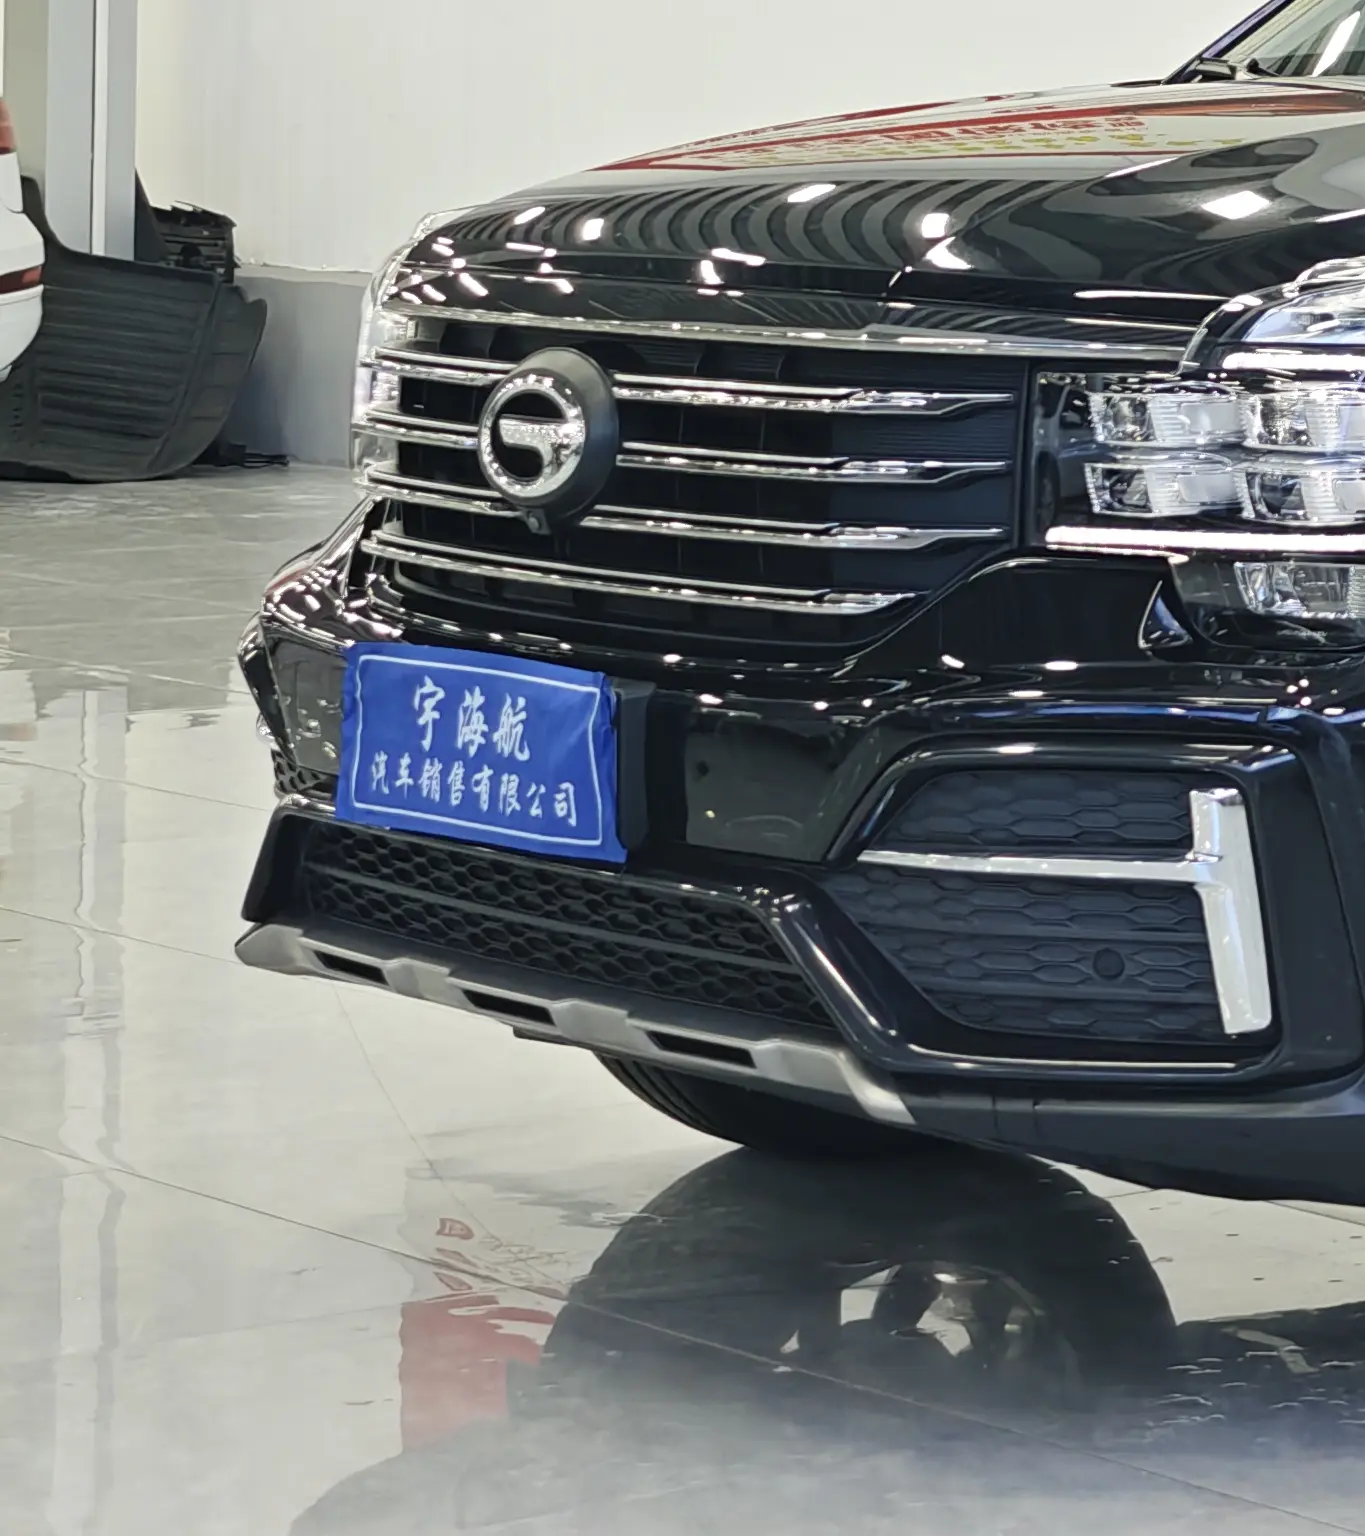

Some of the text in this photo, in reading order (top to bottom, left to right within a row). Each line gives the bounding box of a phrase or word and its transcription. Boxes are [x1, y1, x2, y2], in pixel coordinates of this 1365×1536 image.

[413, 674, 531, 763] 宇海航
[370, 749, 577, 828] 汽车销售有限公司
